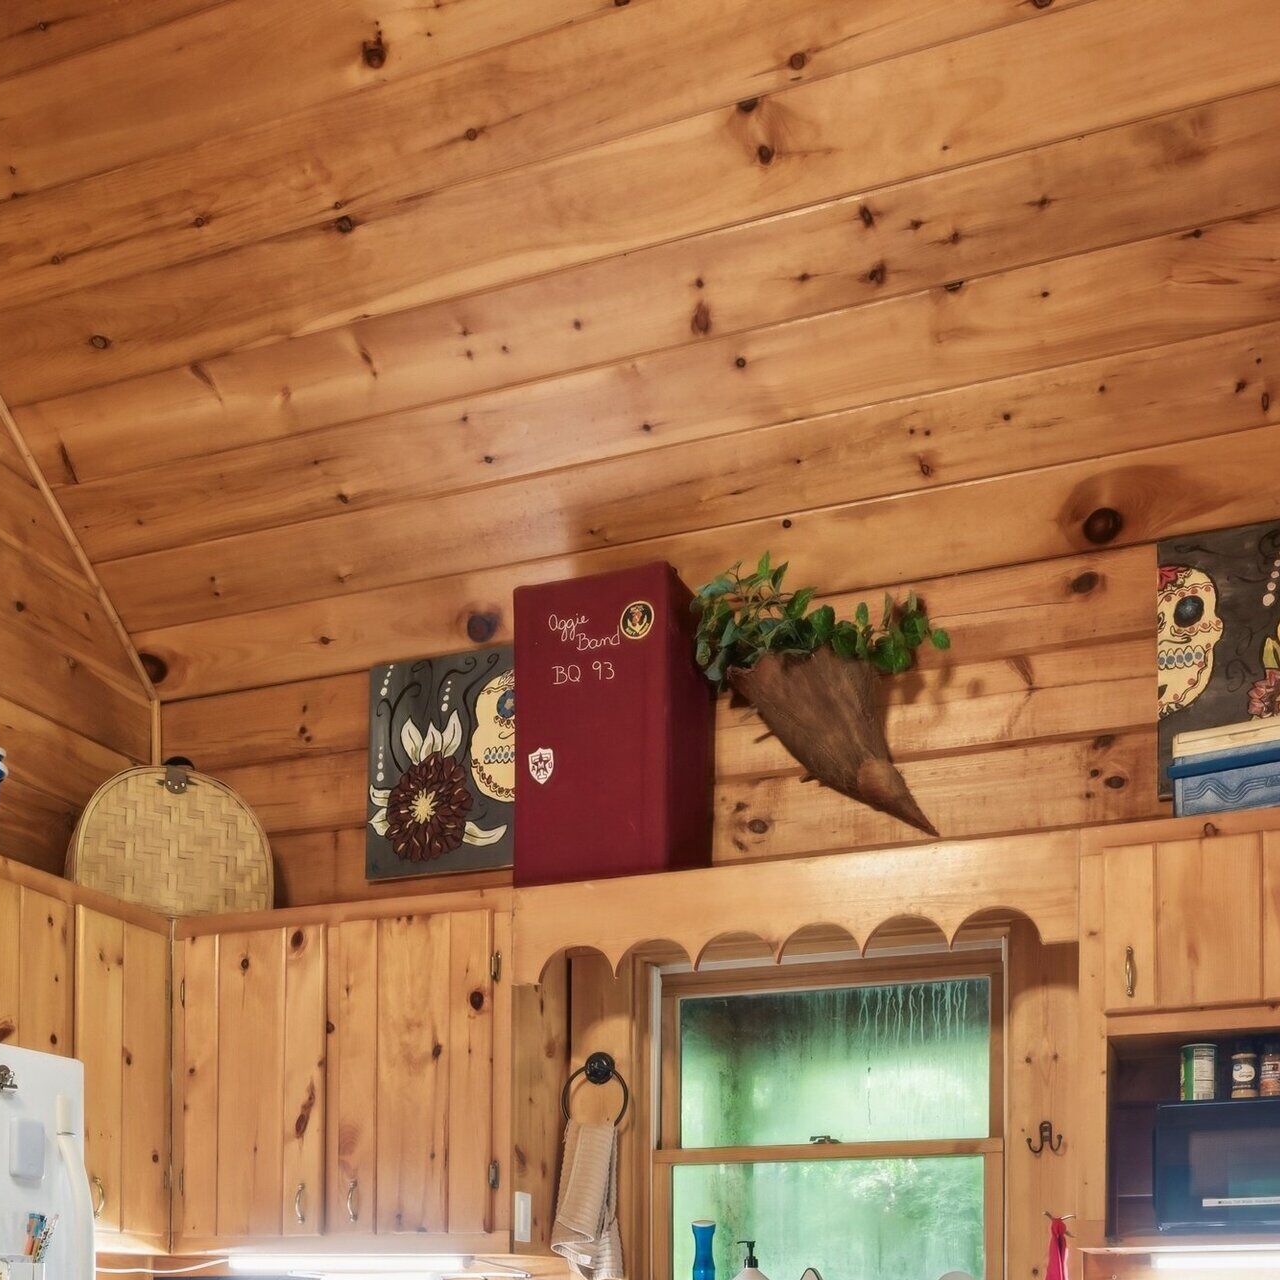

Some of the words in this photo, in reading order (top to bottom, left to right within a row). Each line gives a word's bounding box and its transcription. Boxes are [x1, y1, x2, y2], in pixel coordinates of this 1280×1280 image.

[576, 625, 620, 651] Band
[552, 664, 582, 685] BQ
[592, 660, 615, 681] 93
